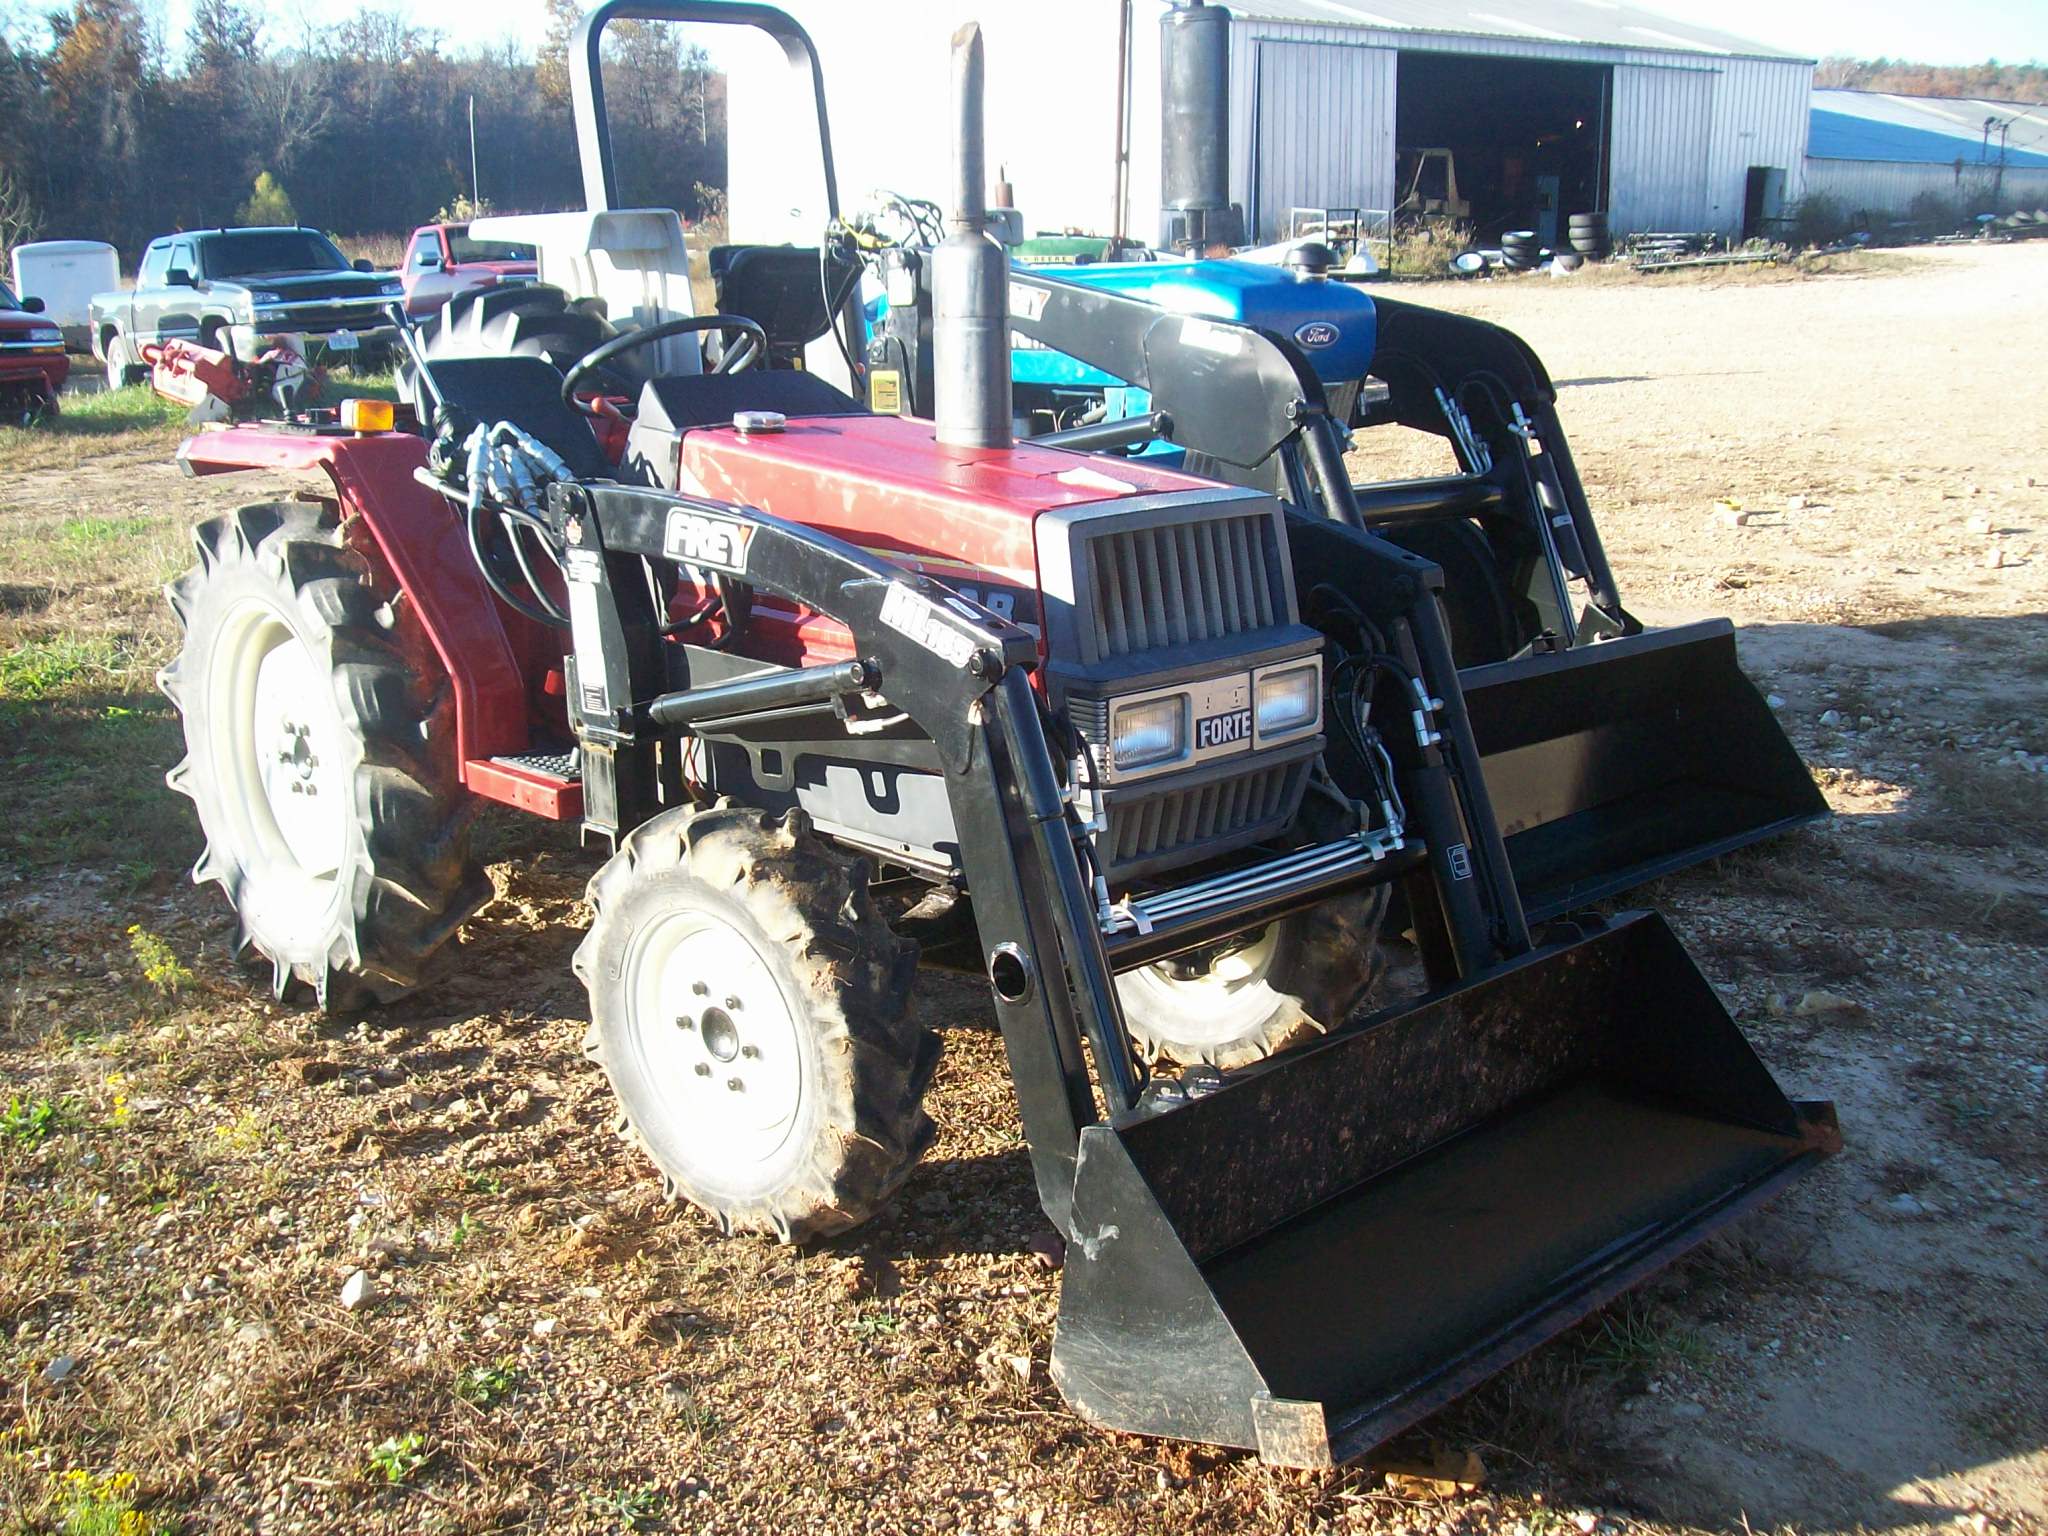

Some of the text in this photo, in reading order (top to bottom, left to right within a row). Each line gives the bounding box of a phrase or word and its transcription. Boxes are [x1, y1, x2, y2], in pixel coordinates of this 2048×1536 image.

[1307, 327, 1330, 343] Ford
[667, 511, 753, 569] FREY
[1199, 711, 1250, 748] FORTE
